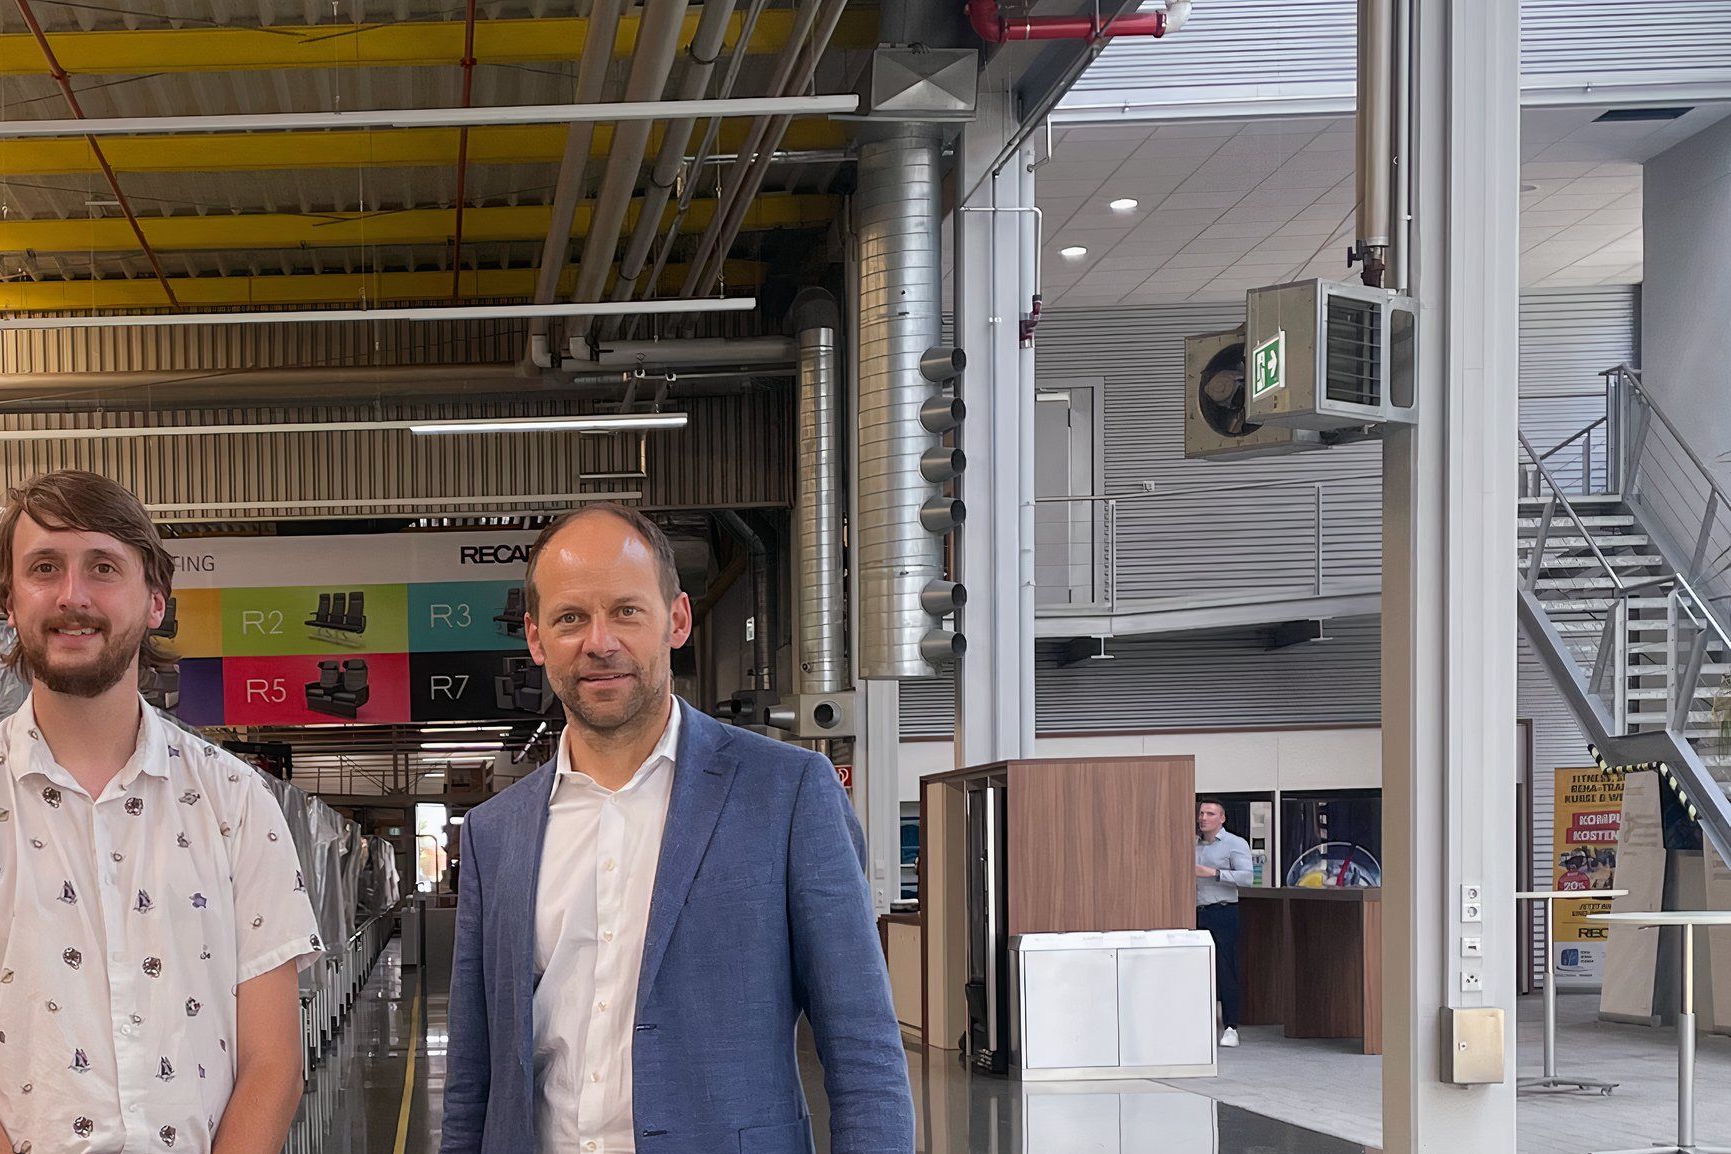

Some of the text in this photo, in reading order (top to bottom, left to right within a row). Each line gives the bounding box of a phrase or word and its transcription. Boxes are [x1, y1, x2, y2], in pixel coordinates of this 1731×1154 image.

[242, 610, 284, 635] R2
[430, 603, 472, 628] R3
[246, 678, 287, 703] R5
[430, 675, 470, 700] R7
